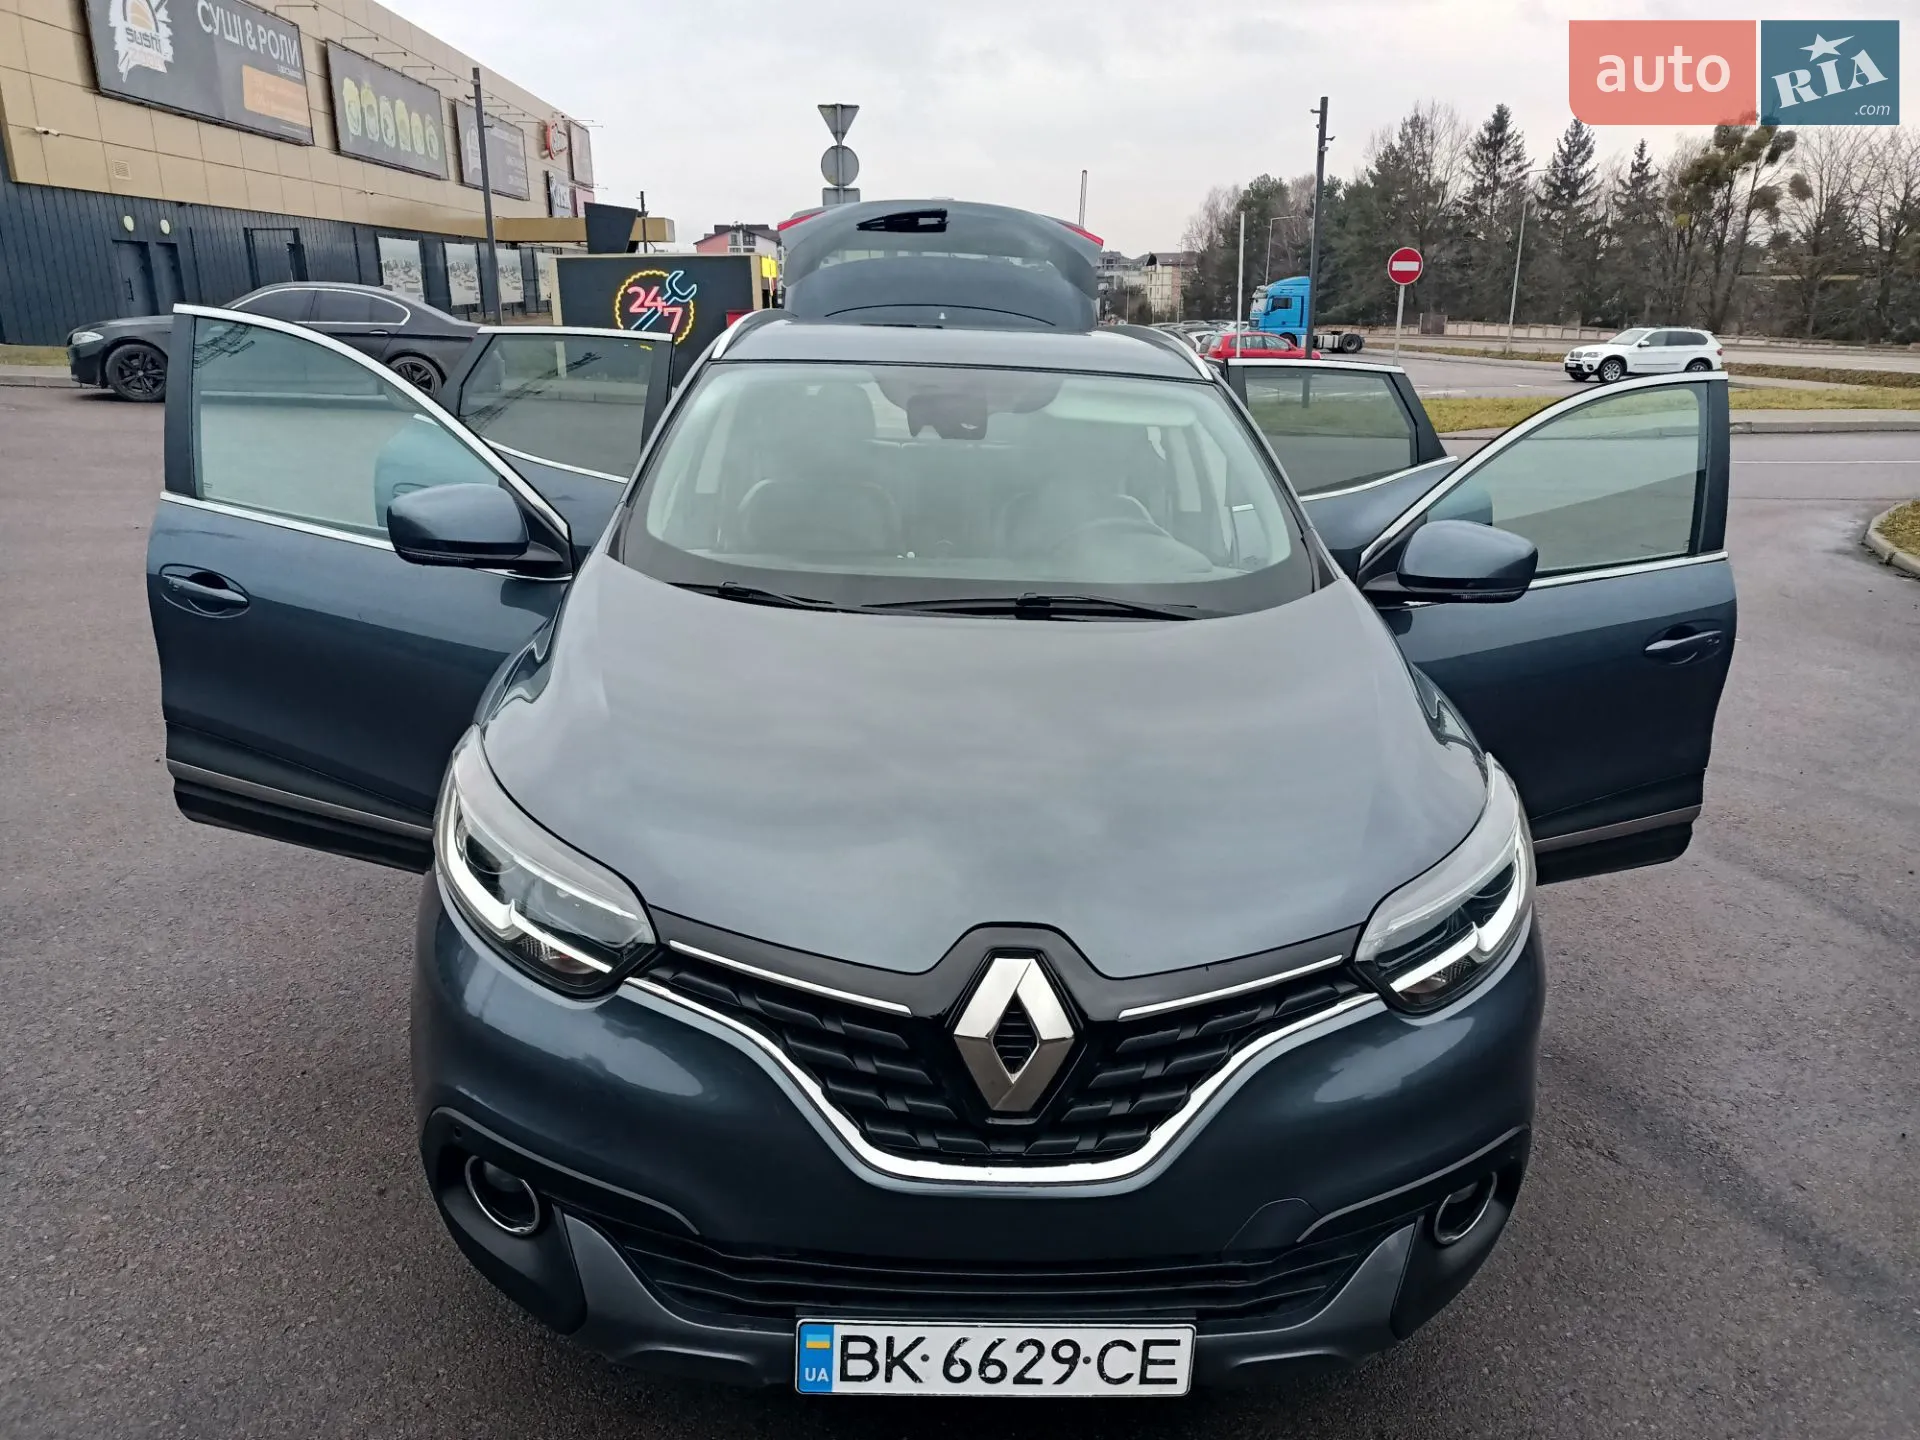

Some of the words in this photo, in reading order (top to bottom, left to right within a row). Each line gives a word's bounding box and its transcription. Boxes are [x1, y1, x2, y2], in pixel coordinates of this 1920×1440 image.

[245, 18, 258, 52] &
[257, 24, 300, 68] РОЛИ
[805, 1367, 830, 1382] UA
